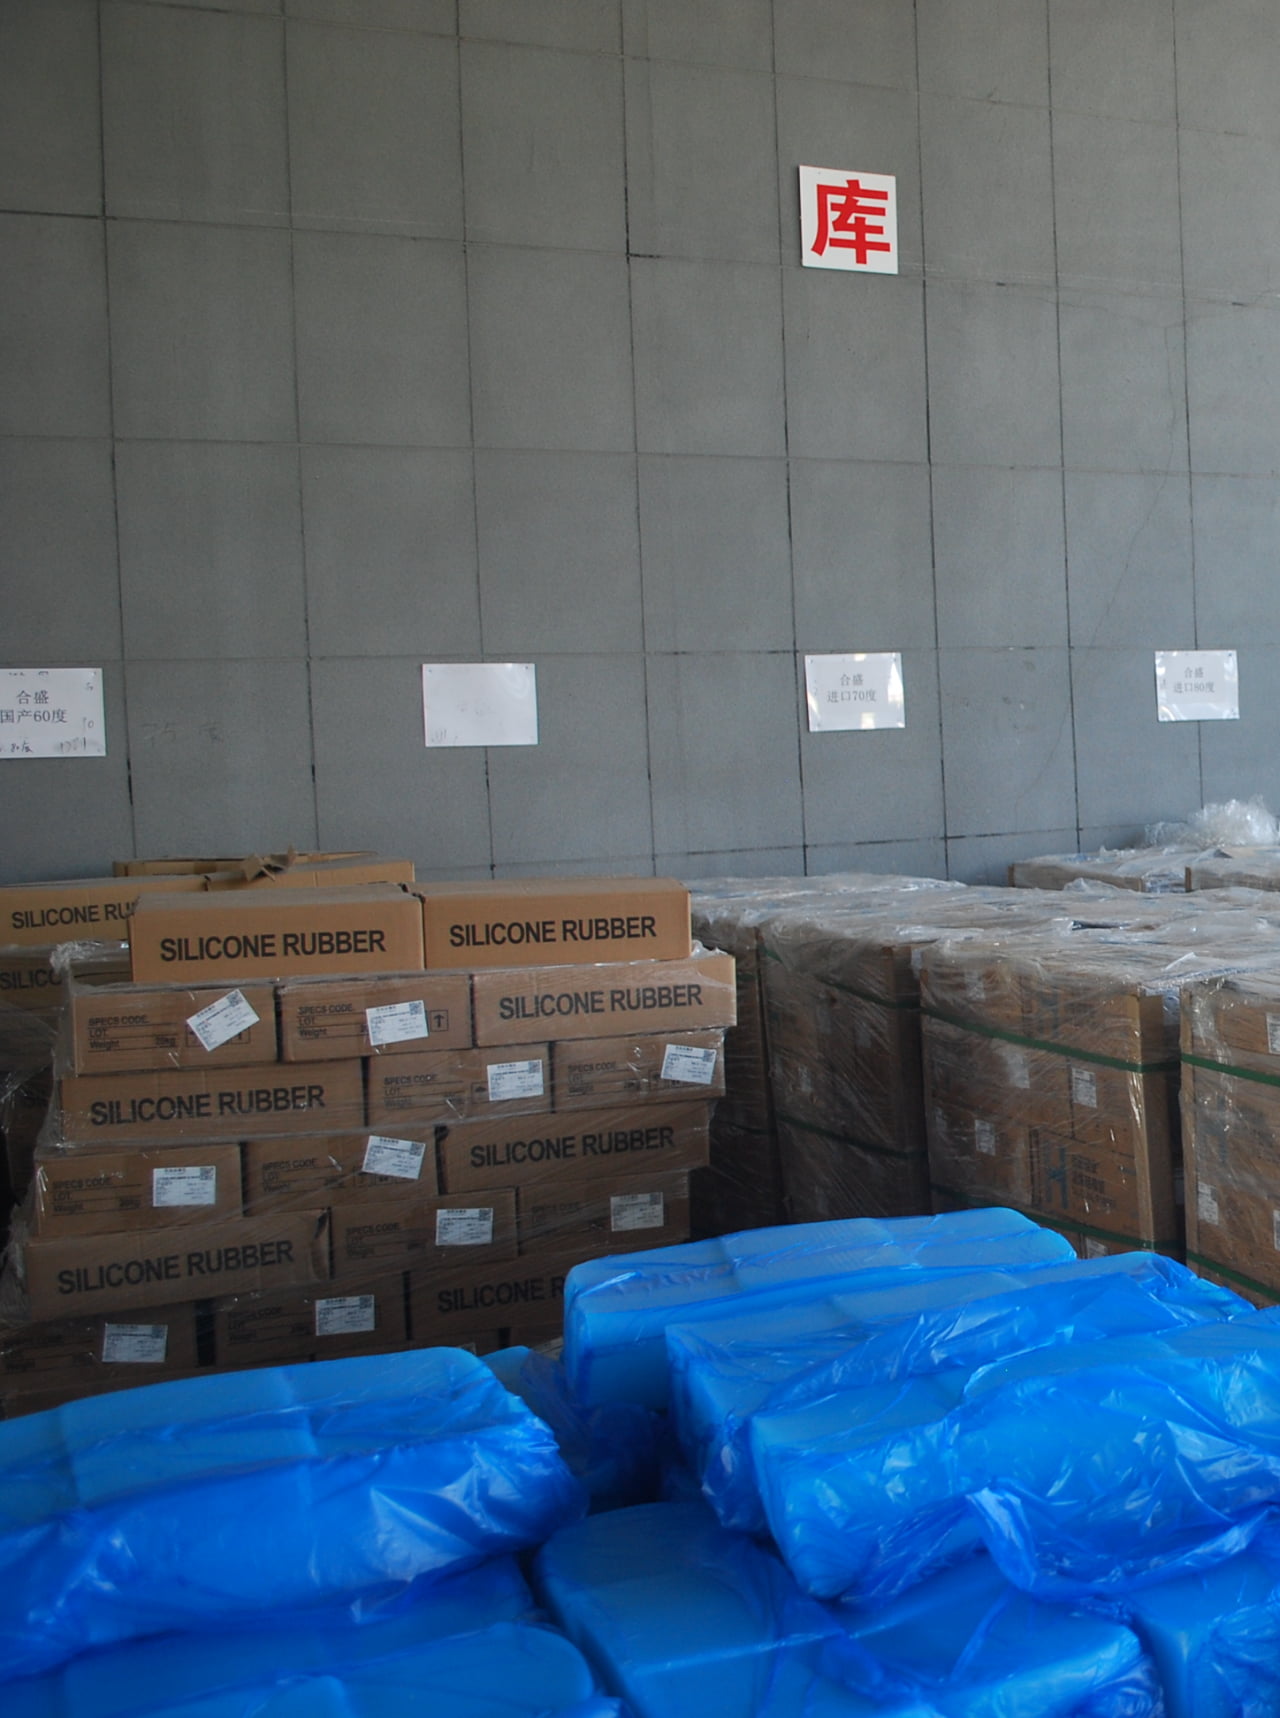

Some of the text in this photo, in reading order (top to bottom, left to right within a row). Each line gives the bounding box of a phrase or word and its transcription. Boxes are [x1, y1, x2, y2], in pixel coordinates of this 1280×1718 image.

[811, 179, 891, 264] 库
[17, 690, 49, 704] 合盛
[0, 708, 68, 723] 国产60度
[12, 904, 99, 929] SILICONE
[450, 916, 657, 948] SILICONE RUBBER
[160, 930, 387, 962] SILICONE RUBBER
[499, 984, 703, 1020] SILICONE RUBBER
[90, 1085, 326, 1126] SILICONE RUBBER
[470, 1126, 674, 1168] SILICONE RUBBER
[57, 1240, 294, 1294] SILICONE RUBBER
[438, 1283, 545, 1314] SILICONE
